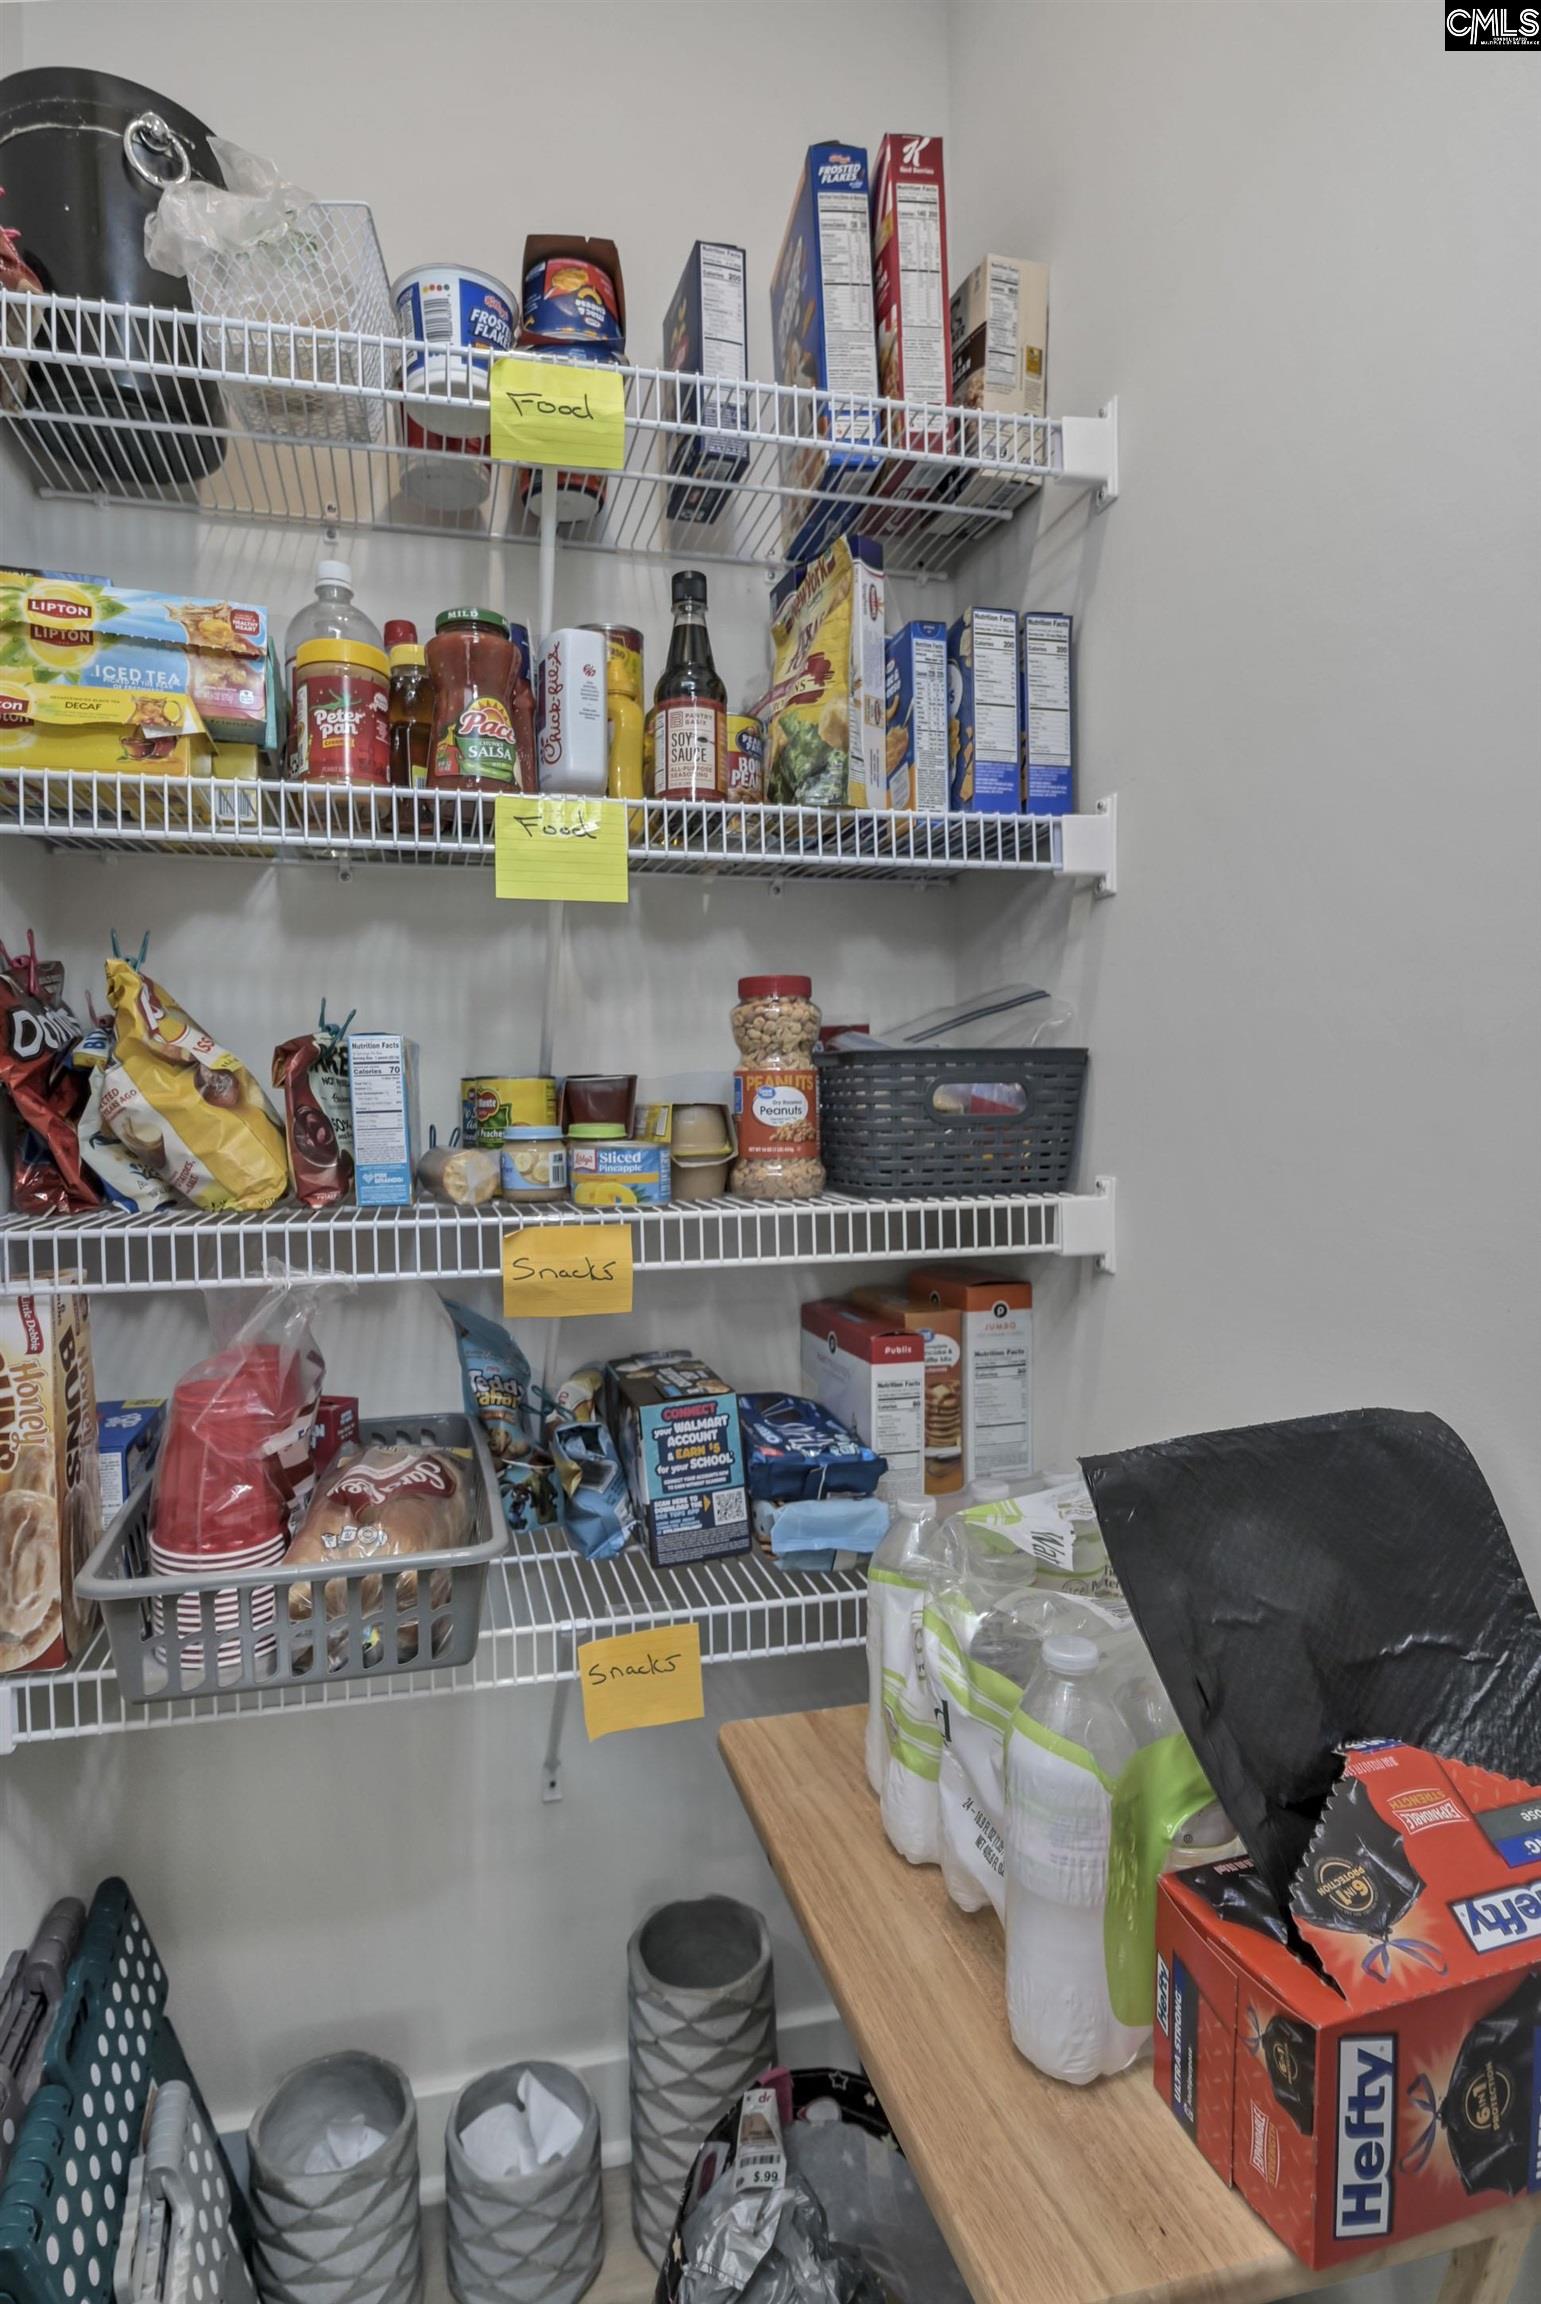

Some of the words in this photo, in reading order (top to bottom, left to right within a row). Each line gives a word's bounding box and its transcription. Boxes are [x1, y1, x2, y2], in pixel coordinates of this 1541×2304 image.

[818, 163, 861, 176] FROSTED
[821, 173, 858, 184] FLAKES
[505, 391, 594, 421] Food
[31, 600, 89, 617] LIPTON
[447, 608, 479, 618] MILD
[33, 627, 91, 643] LIPTON
[95, 664, 142, 681] ICED
[145, 670, 181, 687] TEA
[64, 700, 103, 712] DECAF
[313, 708, 366, 726] Peter
[671, 732, 693, 748] SOY
[468, 745, 512, 760] SALSA
[671, 747, 708, 763] SAUCE
[513, 810, 597, 839] Food
[352, 1042, 381, 1050] Nutrition
[381, 1042, 399, 1050] Facts
[389, 1065, 400, 1074] 70
[746, 1074, 814, 1092] PEANUTS
[119, 1089, 137, 1105] AGO
[760, 1105, 802, 1116] Peanuts
[599, 1152, 642, 1165] Sliced
[599, 1164, 642, 1173] Pineapple
[512, 1257, 616, 1281] Snacks
[25, 1318, 38, 1351] Debbie
[884, 1346, 912, 1355] Publix
[468, 1368, 525, 1397] Teddy
[9, 1360, 50, 1450] Honey
[58, 1325, 82, 1490] BUNS
[662, 1402, 717, 1420] CONNECT
[654, 1427, 673, 1440] your
[673, 1414, 729, 1433] WALMART
[667, 1428, 718, 1447] ACCOUNT
[675, 1445, 706, 1460] EARN
[657, 1465, 669, 1474] for
[670, 1463, 689, 1475] your
[588, 1654, 682, 1686] Snacks
[1389, 1790, 1446, 1809] STRENGTH
[1400, 1802, 1462, 1830] EXPANDABLE
[1316, 1864, 1366, 1897] PROTECTION
[1352, 1879, 1369, 1897] 6
[1462, 1886, 1541, 1939] efty
[1174, 1991, 1182, 2052] STRONG
[1174, 2053, 1182, 2104] ULTRA
[1486, 2060, 1501, 2131] PROTECTION
[1476, 2106, 1491, 2125] 6
[1341, 2047, 1395, 2227] Hefty
[753, 2171, 779, 2183] $.99
